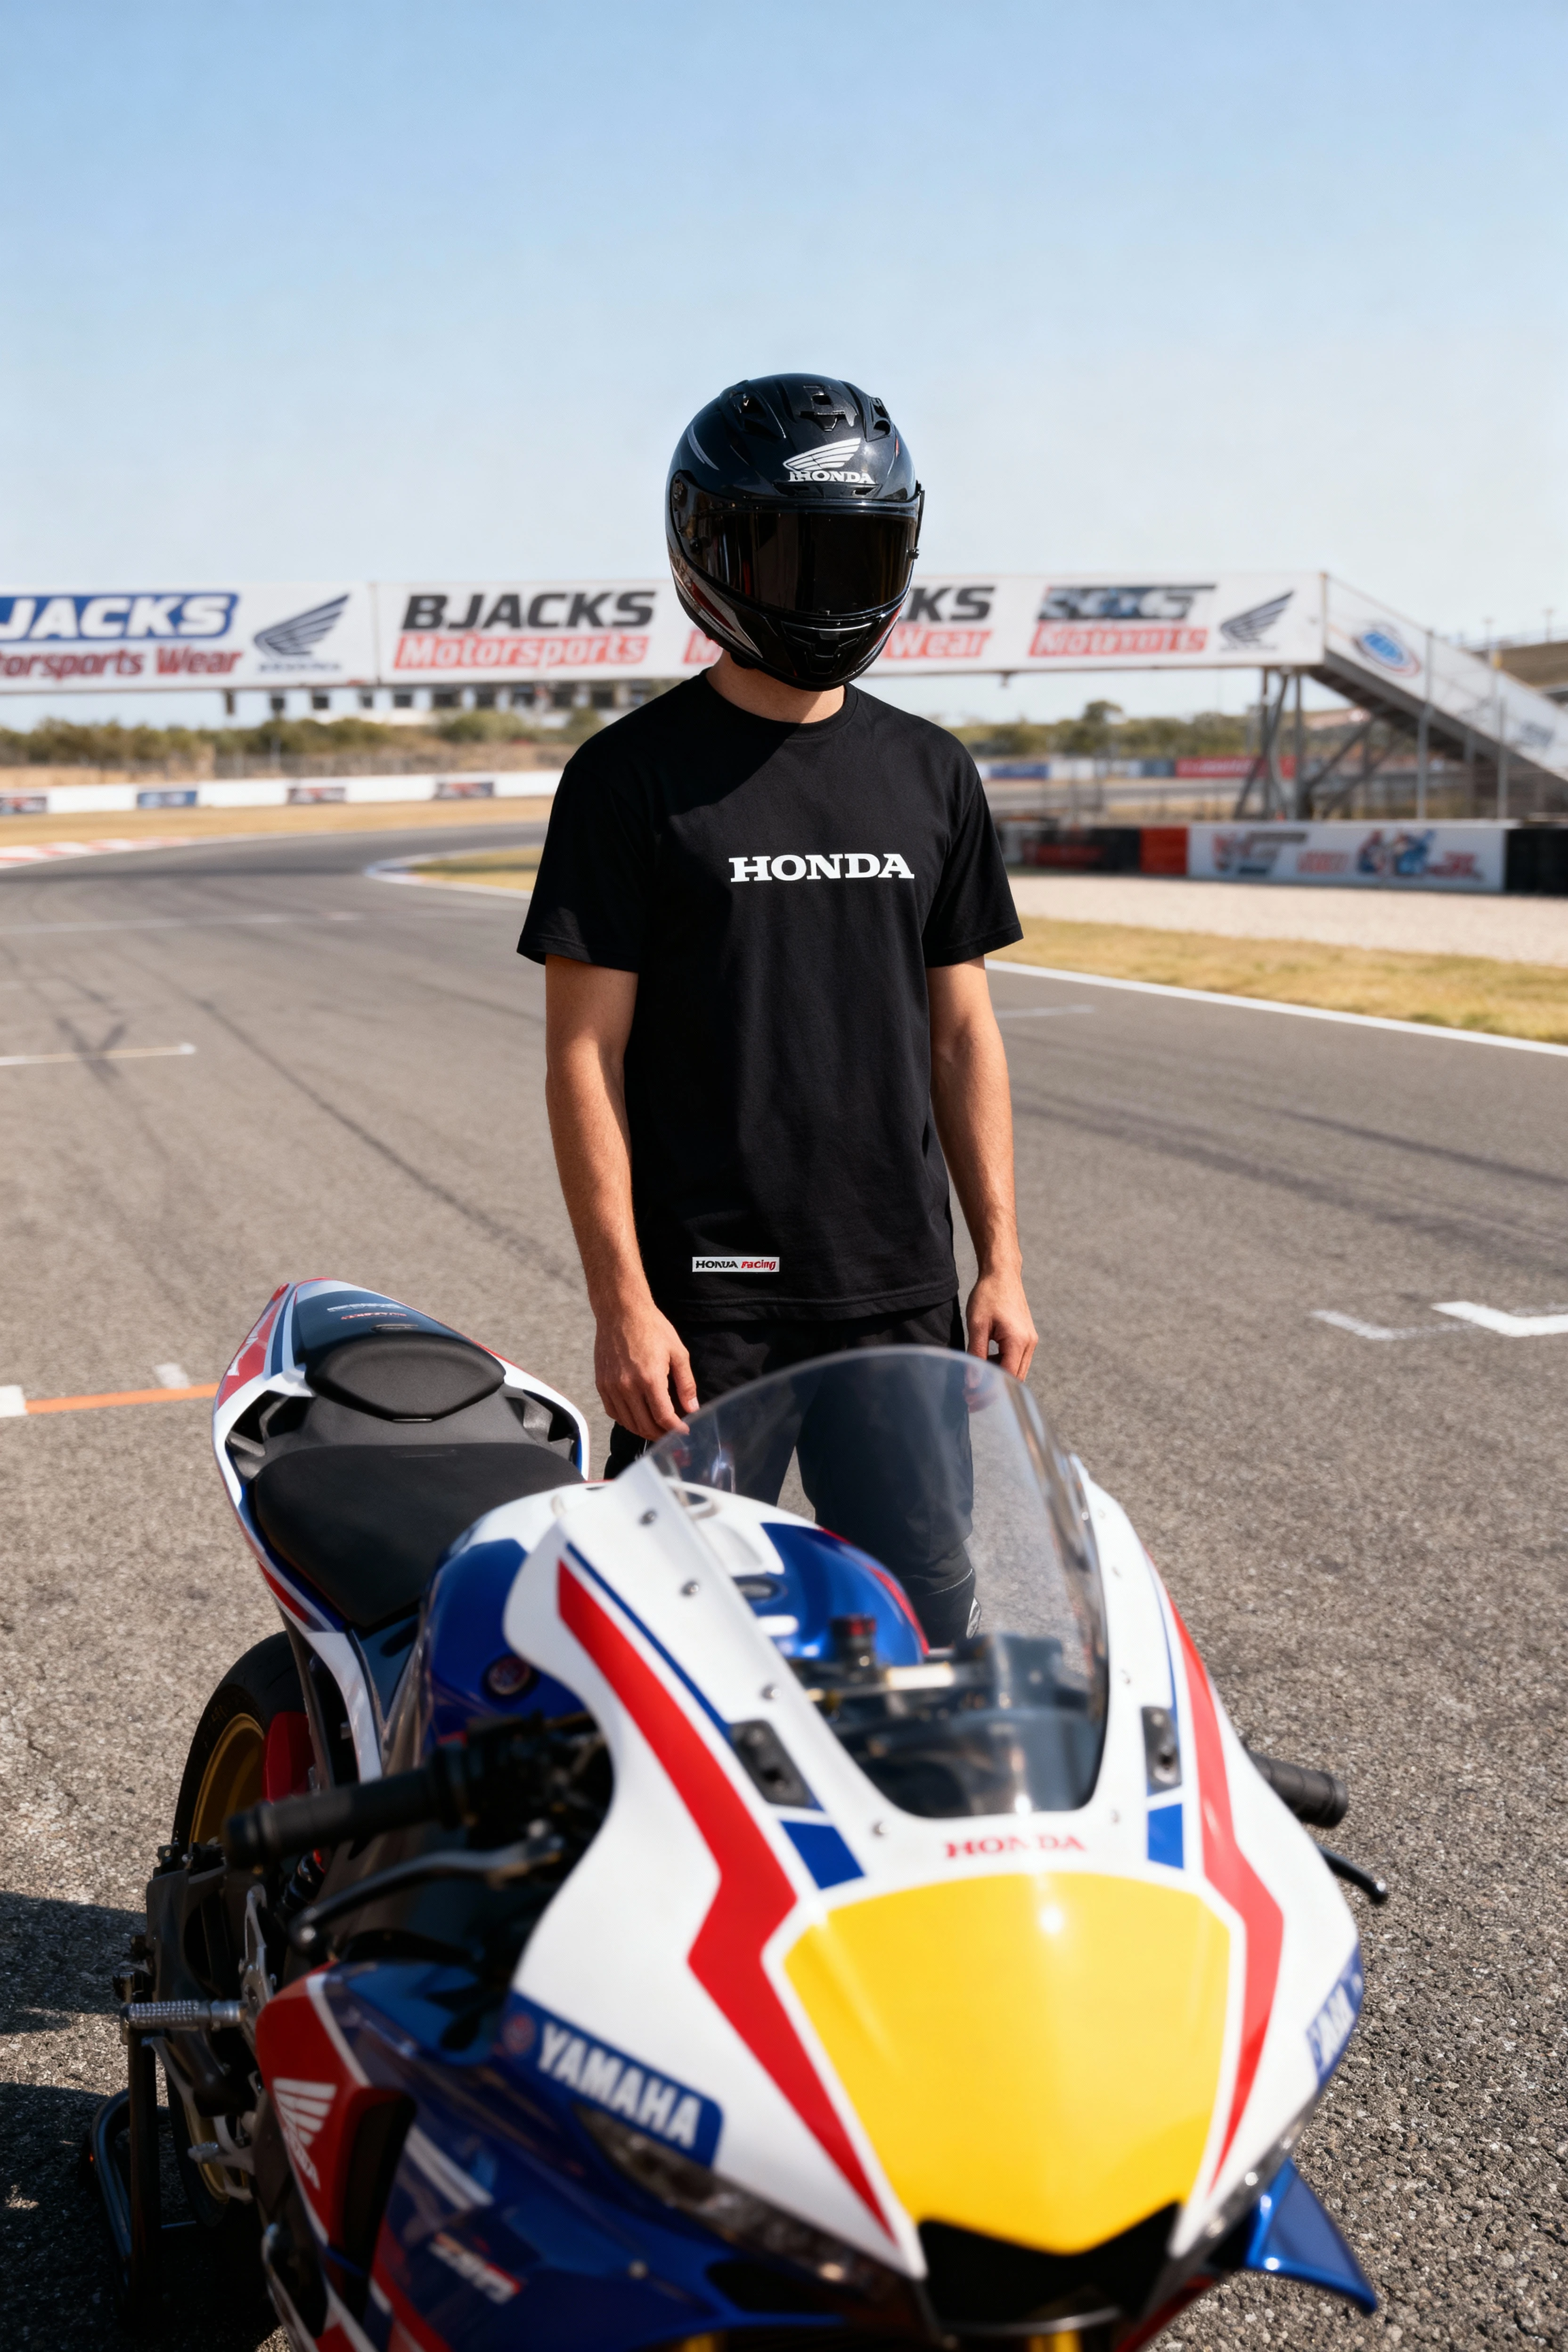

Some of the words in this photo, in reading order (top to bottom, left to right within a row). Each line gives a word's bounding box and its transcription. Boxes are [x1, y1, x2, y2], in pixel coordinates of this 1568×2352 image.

[788, 470, 876, 484] HONDA
[0, 597, 231, 639] JACKS
[402, 591, 656, 630] BJACKS
[898, 587, 996, 621] KS
[156, 645, 243, 675] Wear
[397, 632, 648, 671] Motorsports
[729, 853, 915, 882] HONDA
[538, 2023, 701, 2149] YAMAHA
